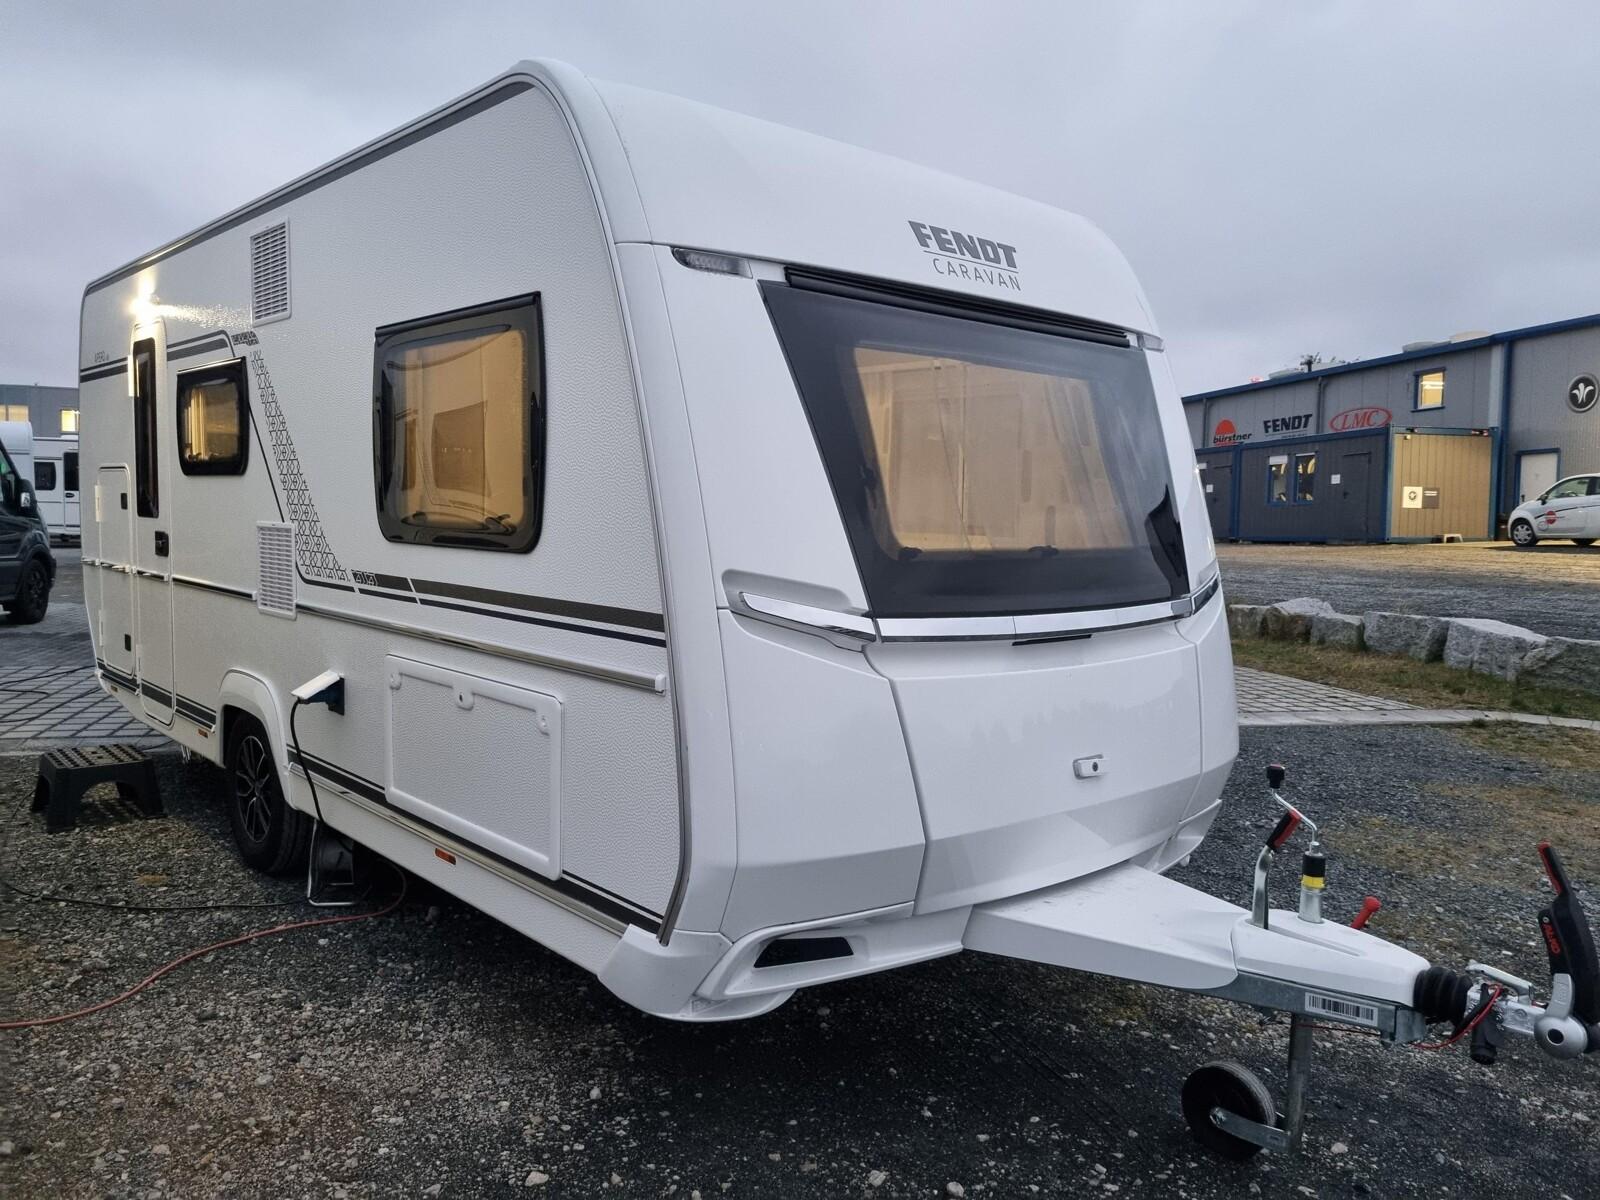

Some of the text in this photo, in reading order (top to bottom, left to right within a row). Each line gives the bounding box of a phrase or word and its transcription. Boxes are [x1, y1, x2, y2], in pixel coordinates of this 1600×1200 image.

[908, 220, 1017, 269] FENDT
[933, 258, 1021, 291] CARAVAN
[1263, 414, 1313, 433] FENDT
[1341, 410, 1380, 429] LMC
[1213, 432, 1252, 444] bürstner
